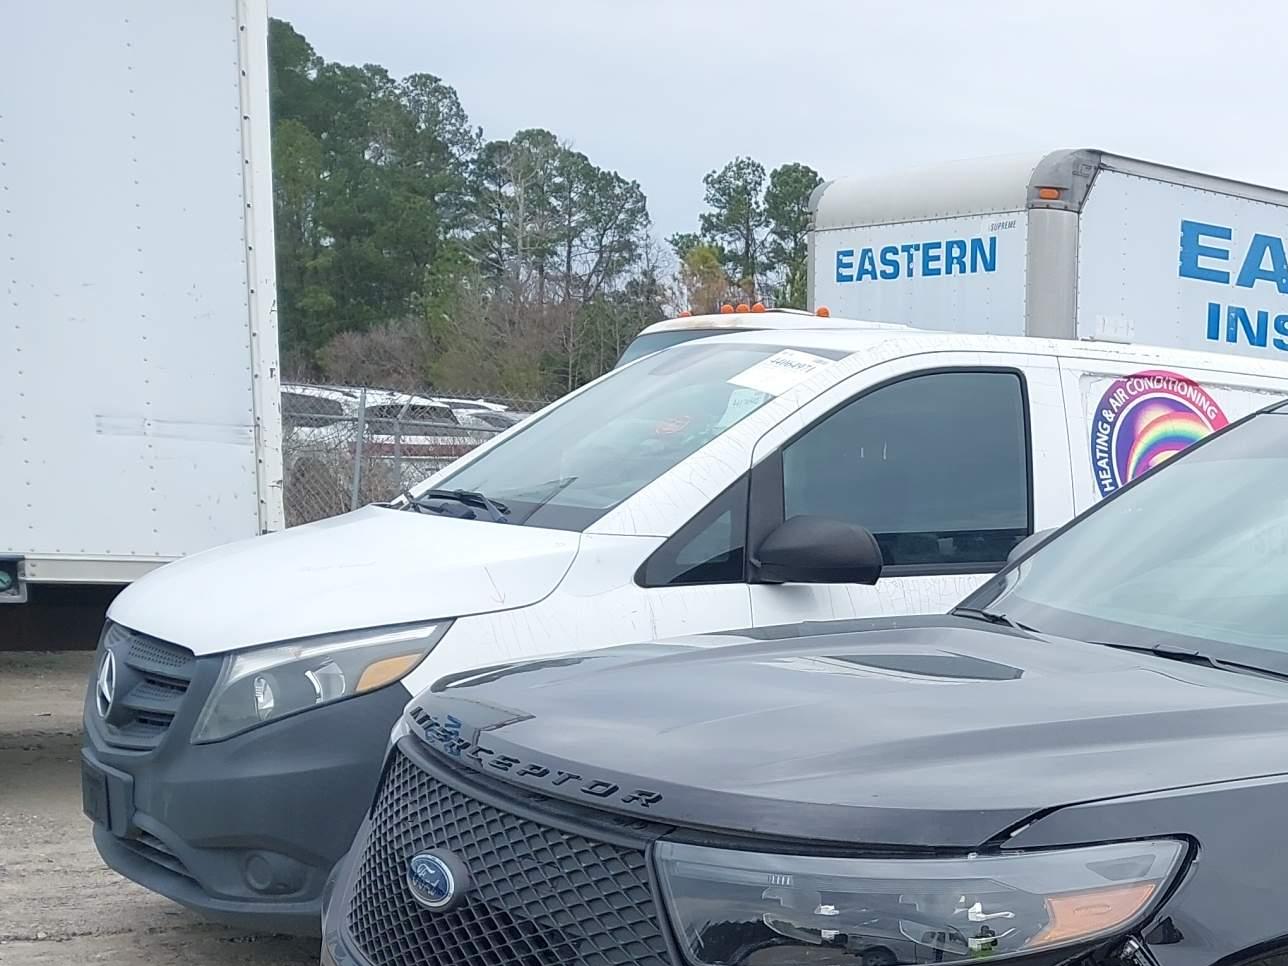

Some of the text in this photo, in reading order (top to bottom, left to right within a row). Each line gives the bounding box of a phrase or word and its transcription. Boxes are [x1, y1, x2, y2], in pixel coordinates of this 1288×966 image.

[990, 220, 1016, 231] SUPREME
[835, 235, 998, 284] EASTERN
[1096, 375, 1218, 492] HEATING & AIR CONDITIONING
